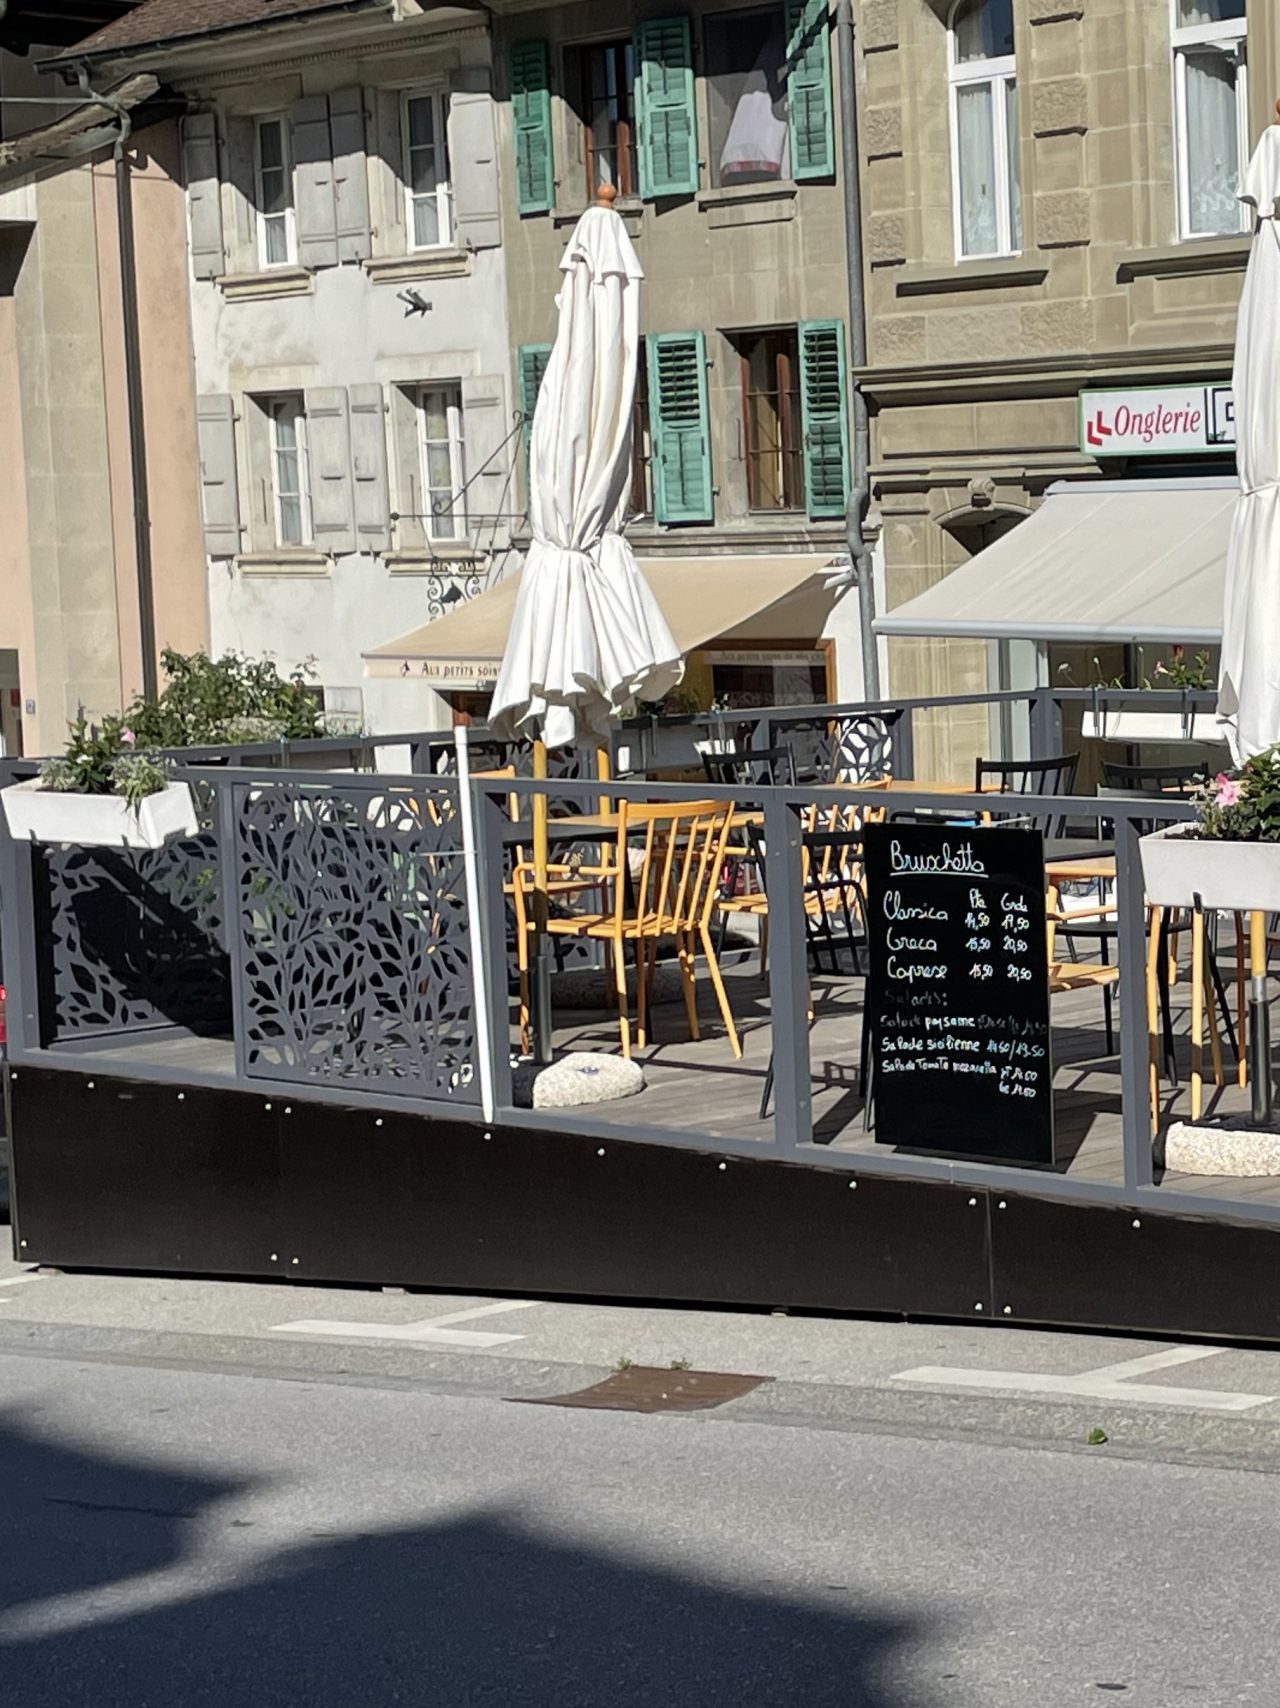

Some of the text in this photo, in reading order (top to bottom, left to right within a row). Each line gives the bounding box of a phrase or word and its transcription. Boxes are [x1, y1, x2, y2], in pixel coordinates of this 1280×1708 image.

[1114, 402, 1201, 443] Onglerie
[477, 662, 501, 676] soin
[883, 890, 949, 921] Classica
[886, 926, 938, 952] Greca
[1003, 935, 1028, 954] 20,50
[887, 955, 948, 983] Caprese
[1007, 964, 1032, 982] 20,50
[881, 1035, 924, 1052] Salade
